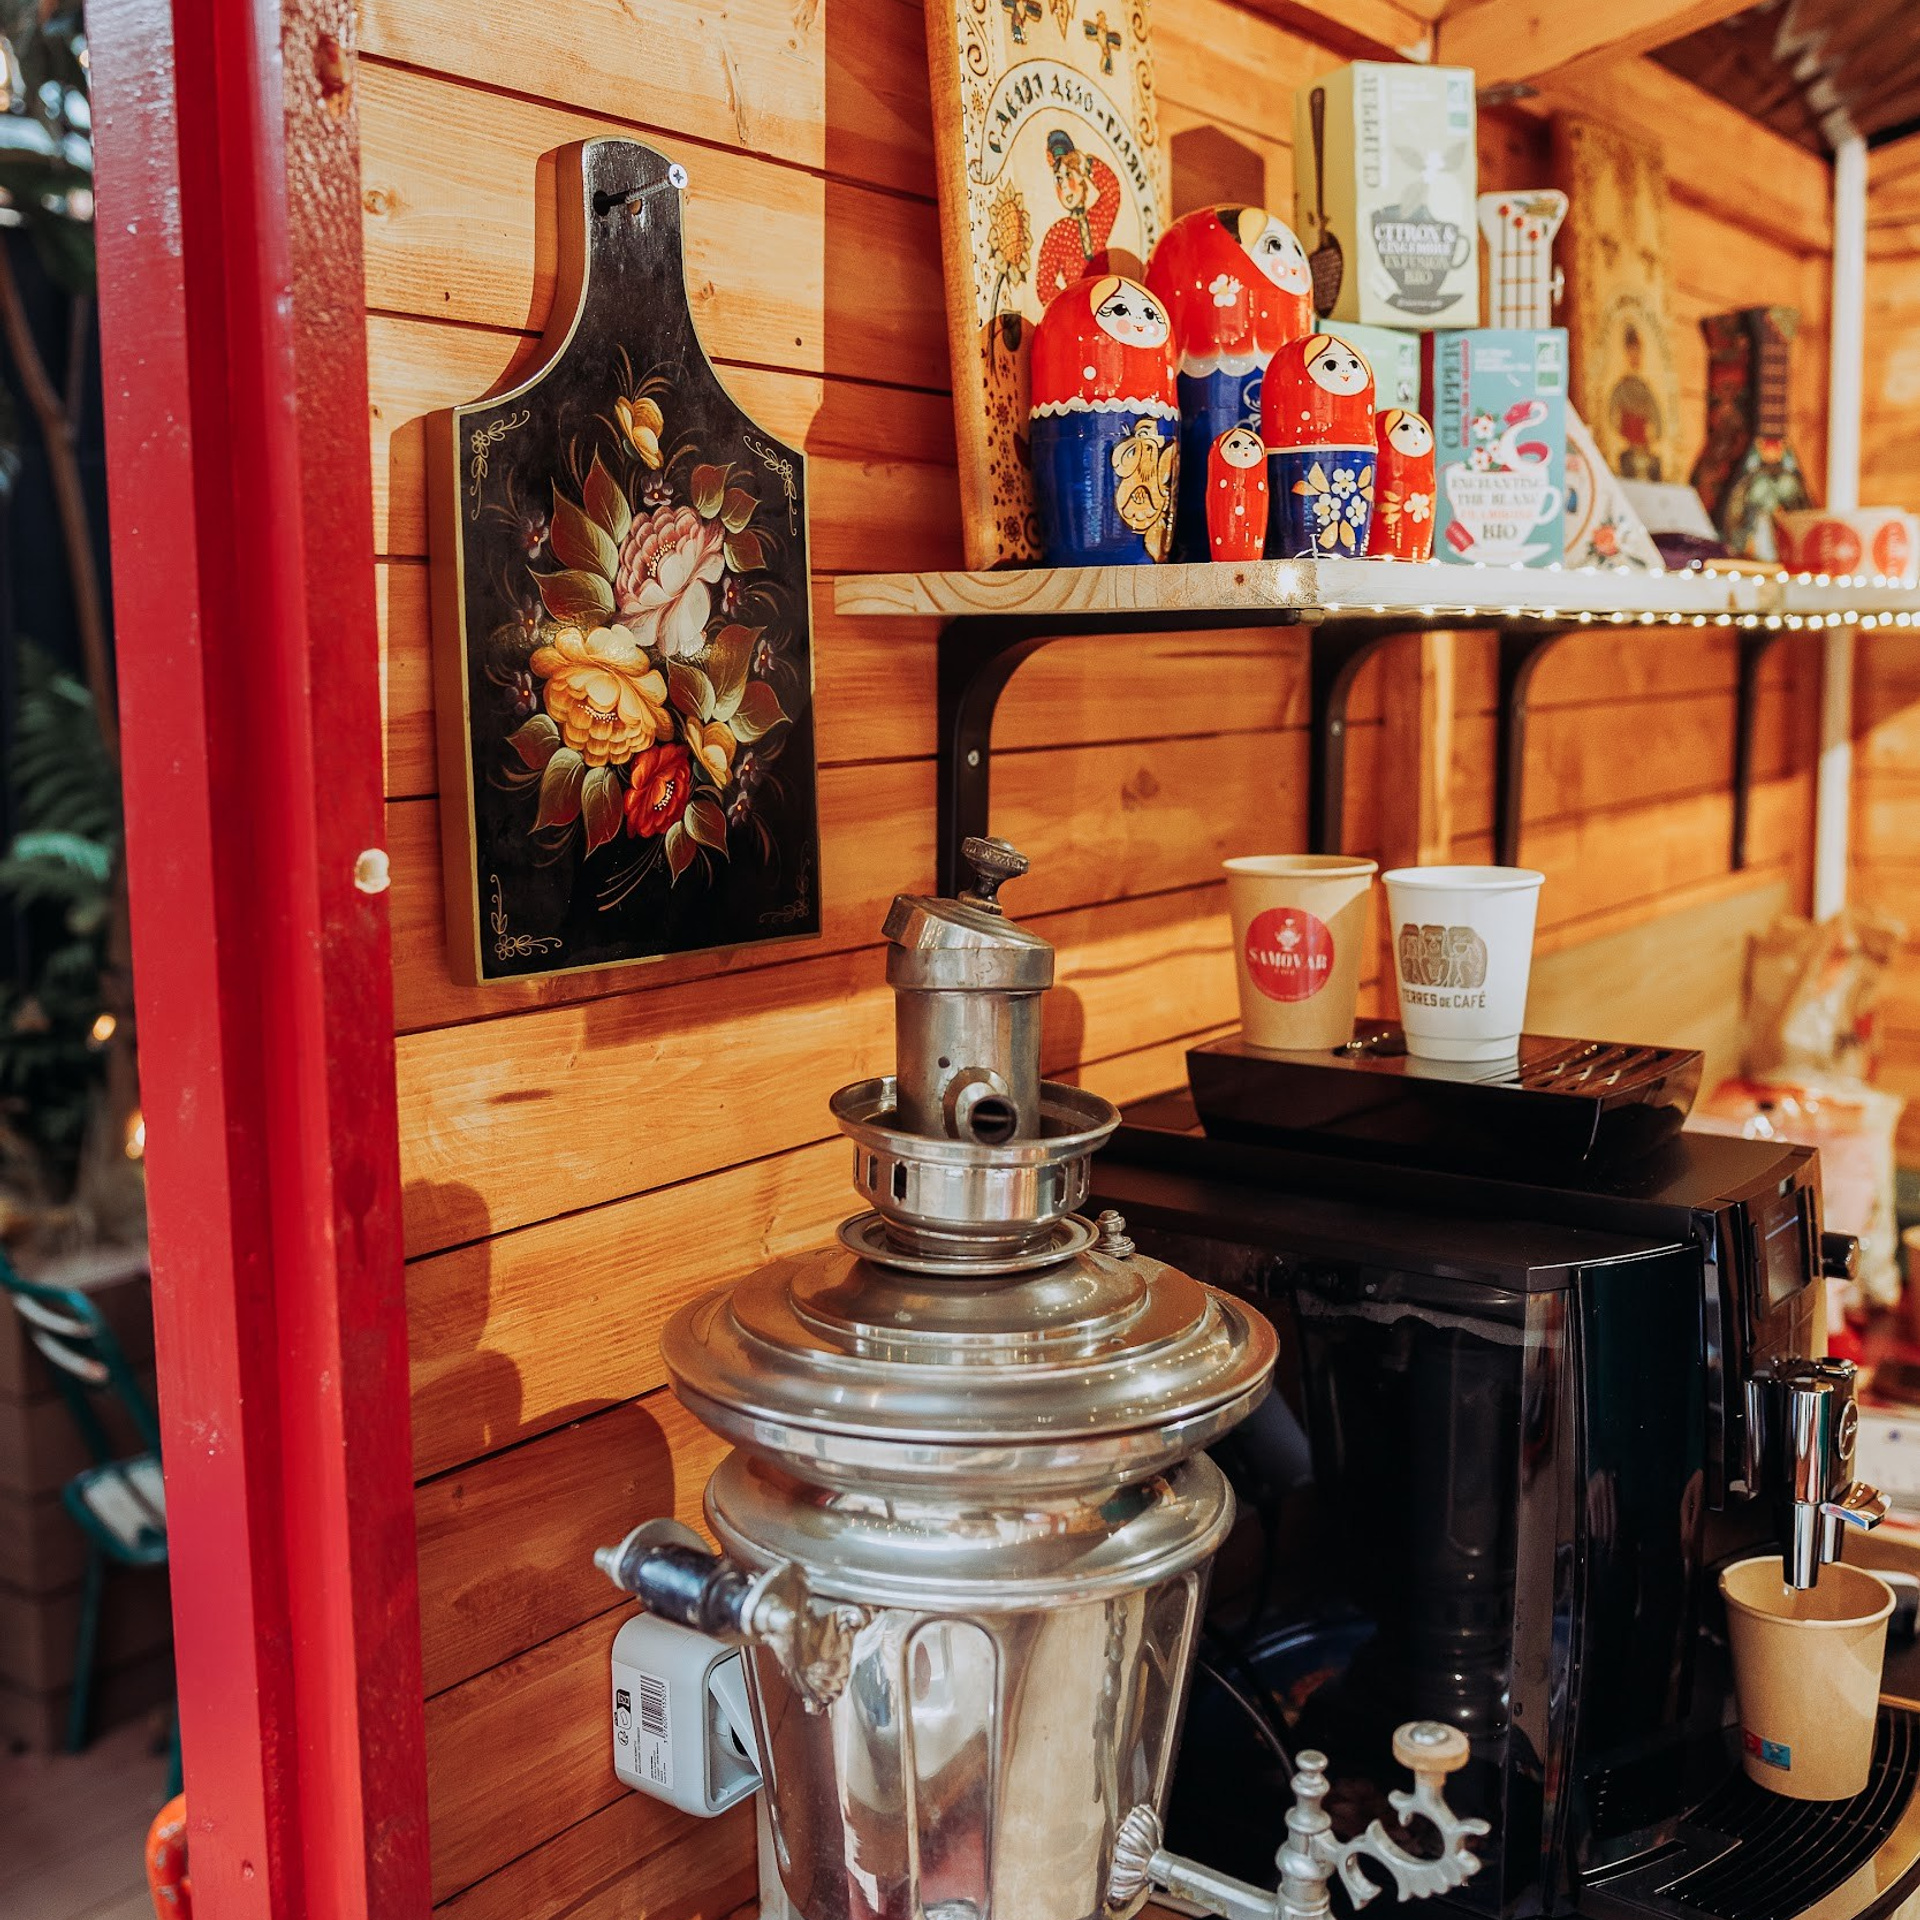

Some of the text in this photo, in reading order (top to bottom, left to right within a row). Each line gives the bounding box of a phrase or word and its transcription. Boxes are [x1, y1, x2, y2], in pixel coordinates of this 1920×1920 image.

[1361, 74, 1380, 188] CLIPPER
[1374, 222, 1440, 242] CITRON
[1404, 269, 1434, 286] BIO
[1442, 340, 1460, 449] CLIPPER
[1482, 524, 1517, 540] BIO
[1248, 946, 1328, 970] SAMOVAR
[1402, 988, 1438, 1007] TERRES
[1453, 990, 1486, 1009] CAFÉ
